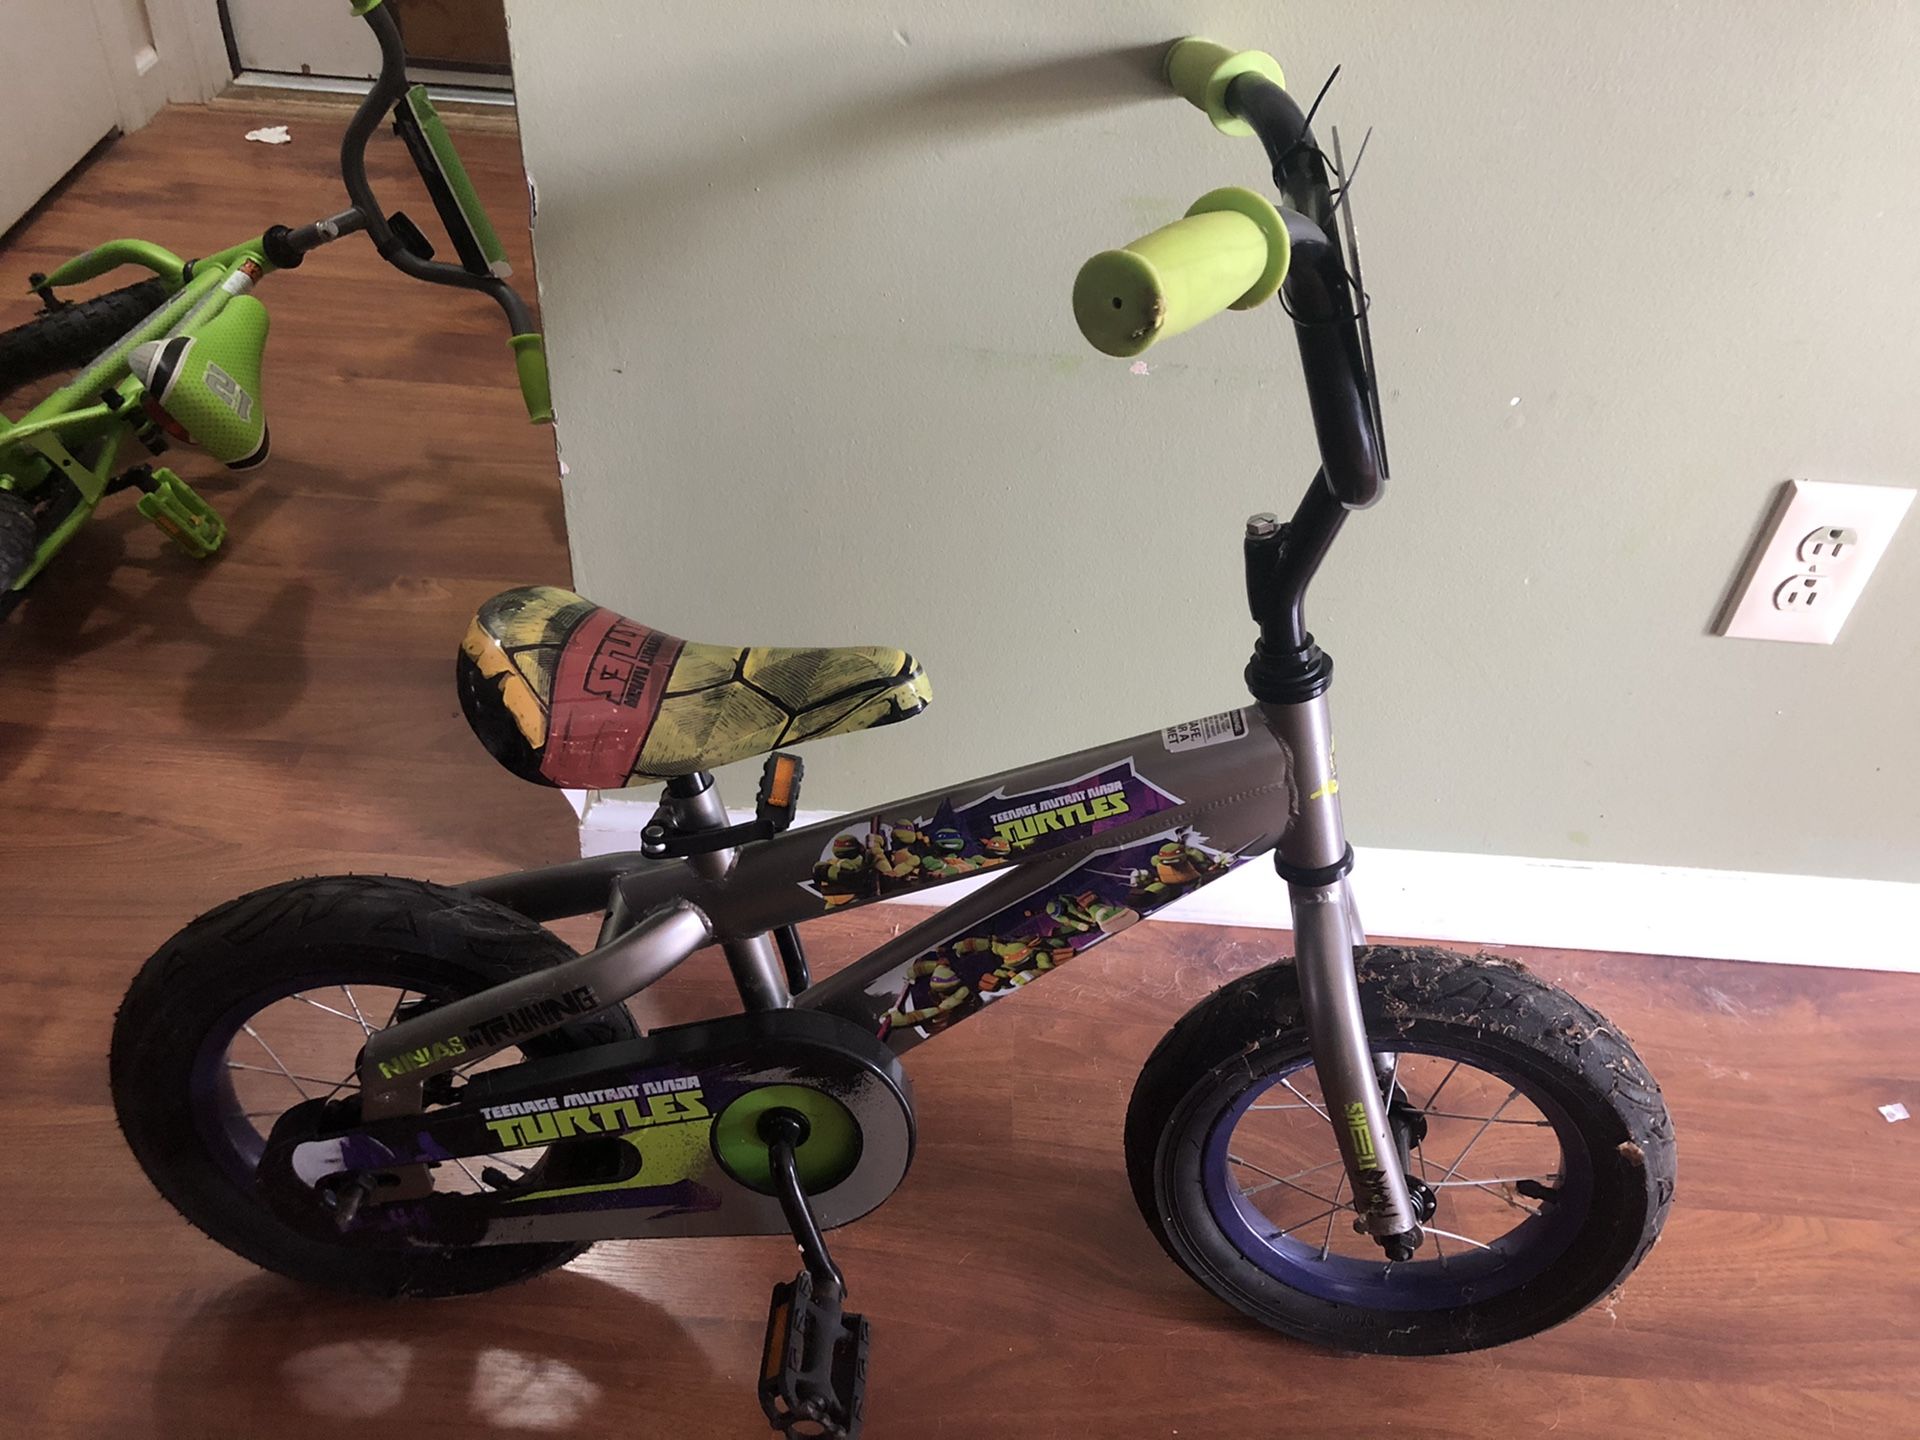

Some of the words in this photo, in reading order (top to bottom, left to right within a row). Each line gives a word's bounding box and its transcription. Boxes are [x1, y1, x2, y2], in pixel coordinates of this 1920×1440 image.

[1180, 734, 1189, 742] A
[1189, 719, 1201, 741] AFE,
[990, 803, 1037, 824] TEENAGE
[1040, 790, 1086, 812] MUTANT
[1088, 780, 1123, 798] NINJA
[994, 791, 1130, 842] TURTLES
[378, 1036, 466, 1079] NINJAS
[468, 985, 599, 1046] TRAINING
[480, 1096, 559, 1120] TEENAGE
[563, 1084, 639, 1107] MUTANT
[642, 1075, 701, 1096] NINJA
[486, 1089, 709, 1147] TURTLES
